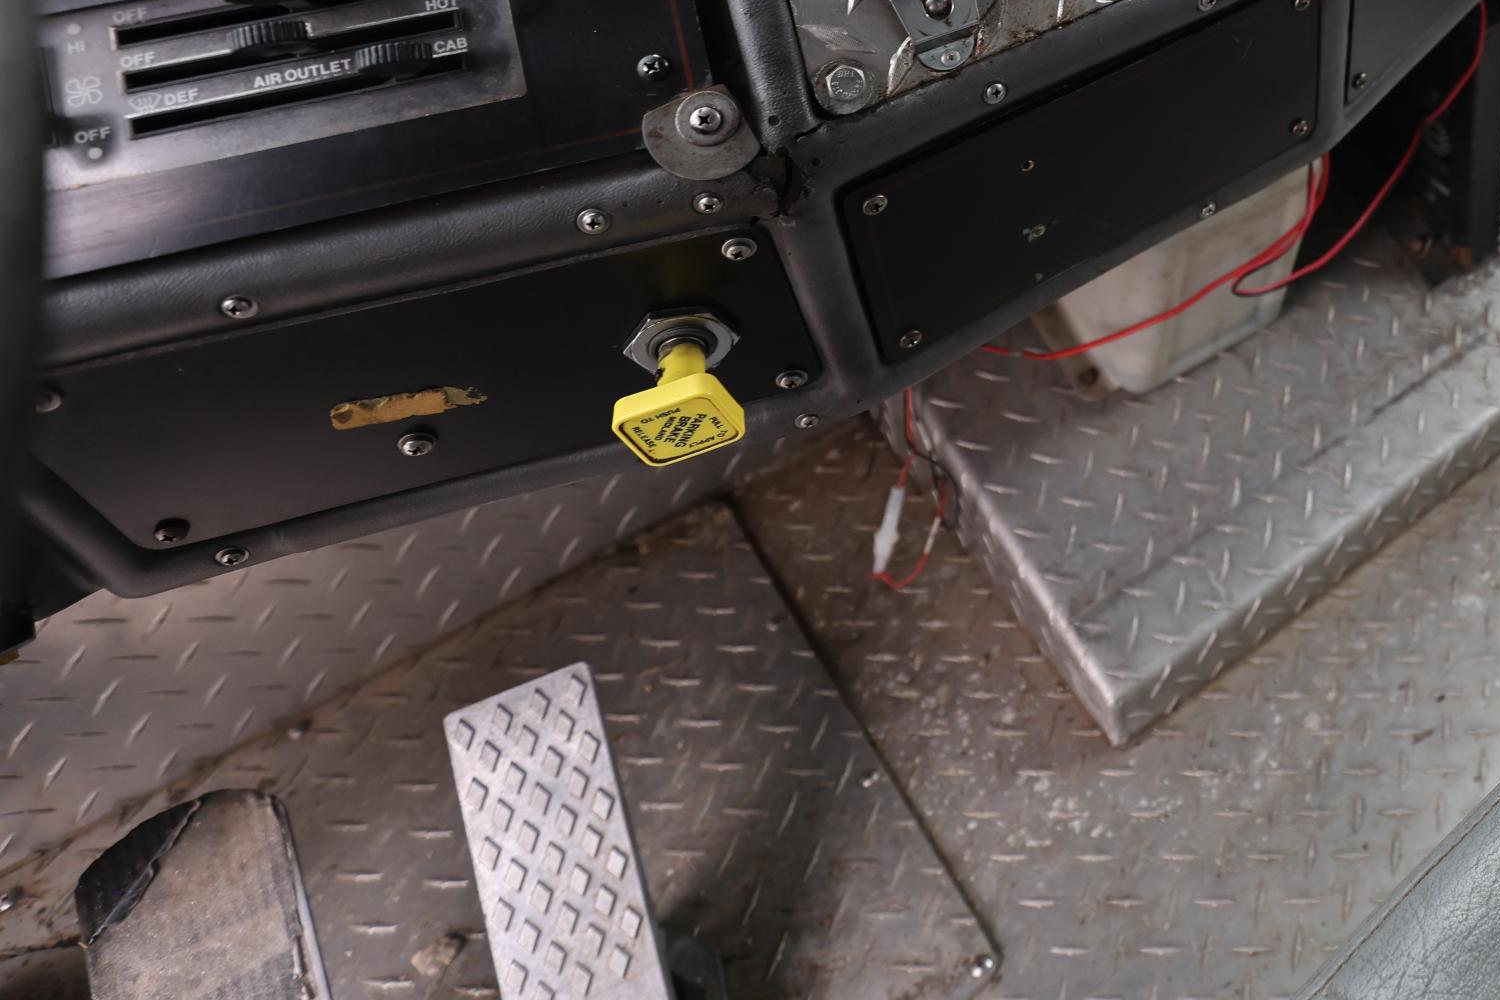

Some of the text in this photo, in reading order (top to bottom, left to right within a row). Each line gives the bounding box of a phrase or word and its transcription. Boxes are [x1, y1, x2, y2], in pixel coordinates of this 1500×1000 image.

[112, 6, 148, 24] OFF
[432, 36, 468, 54] CAB
[119, 50, 156, 69] OFF
[253, 58, 352, 89] AIR OUTLET
[163, 88, 199, 106] DEF
[74, 126, 111, 144] OFF
[656, 408, 680, 419] PUSH
[631, 426, 657, 449] RELEASE
[654, 416, 677, 441] MIDLAND
[664, 416, 691, 444] BRAKE
[674, 413, 708, 448] PARKING
[688, 436, 714, 448] APPLY
